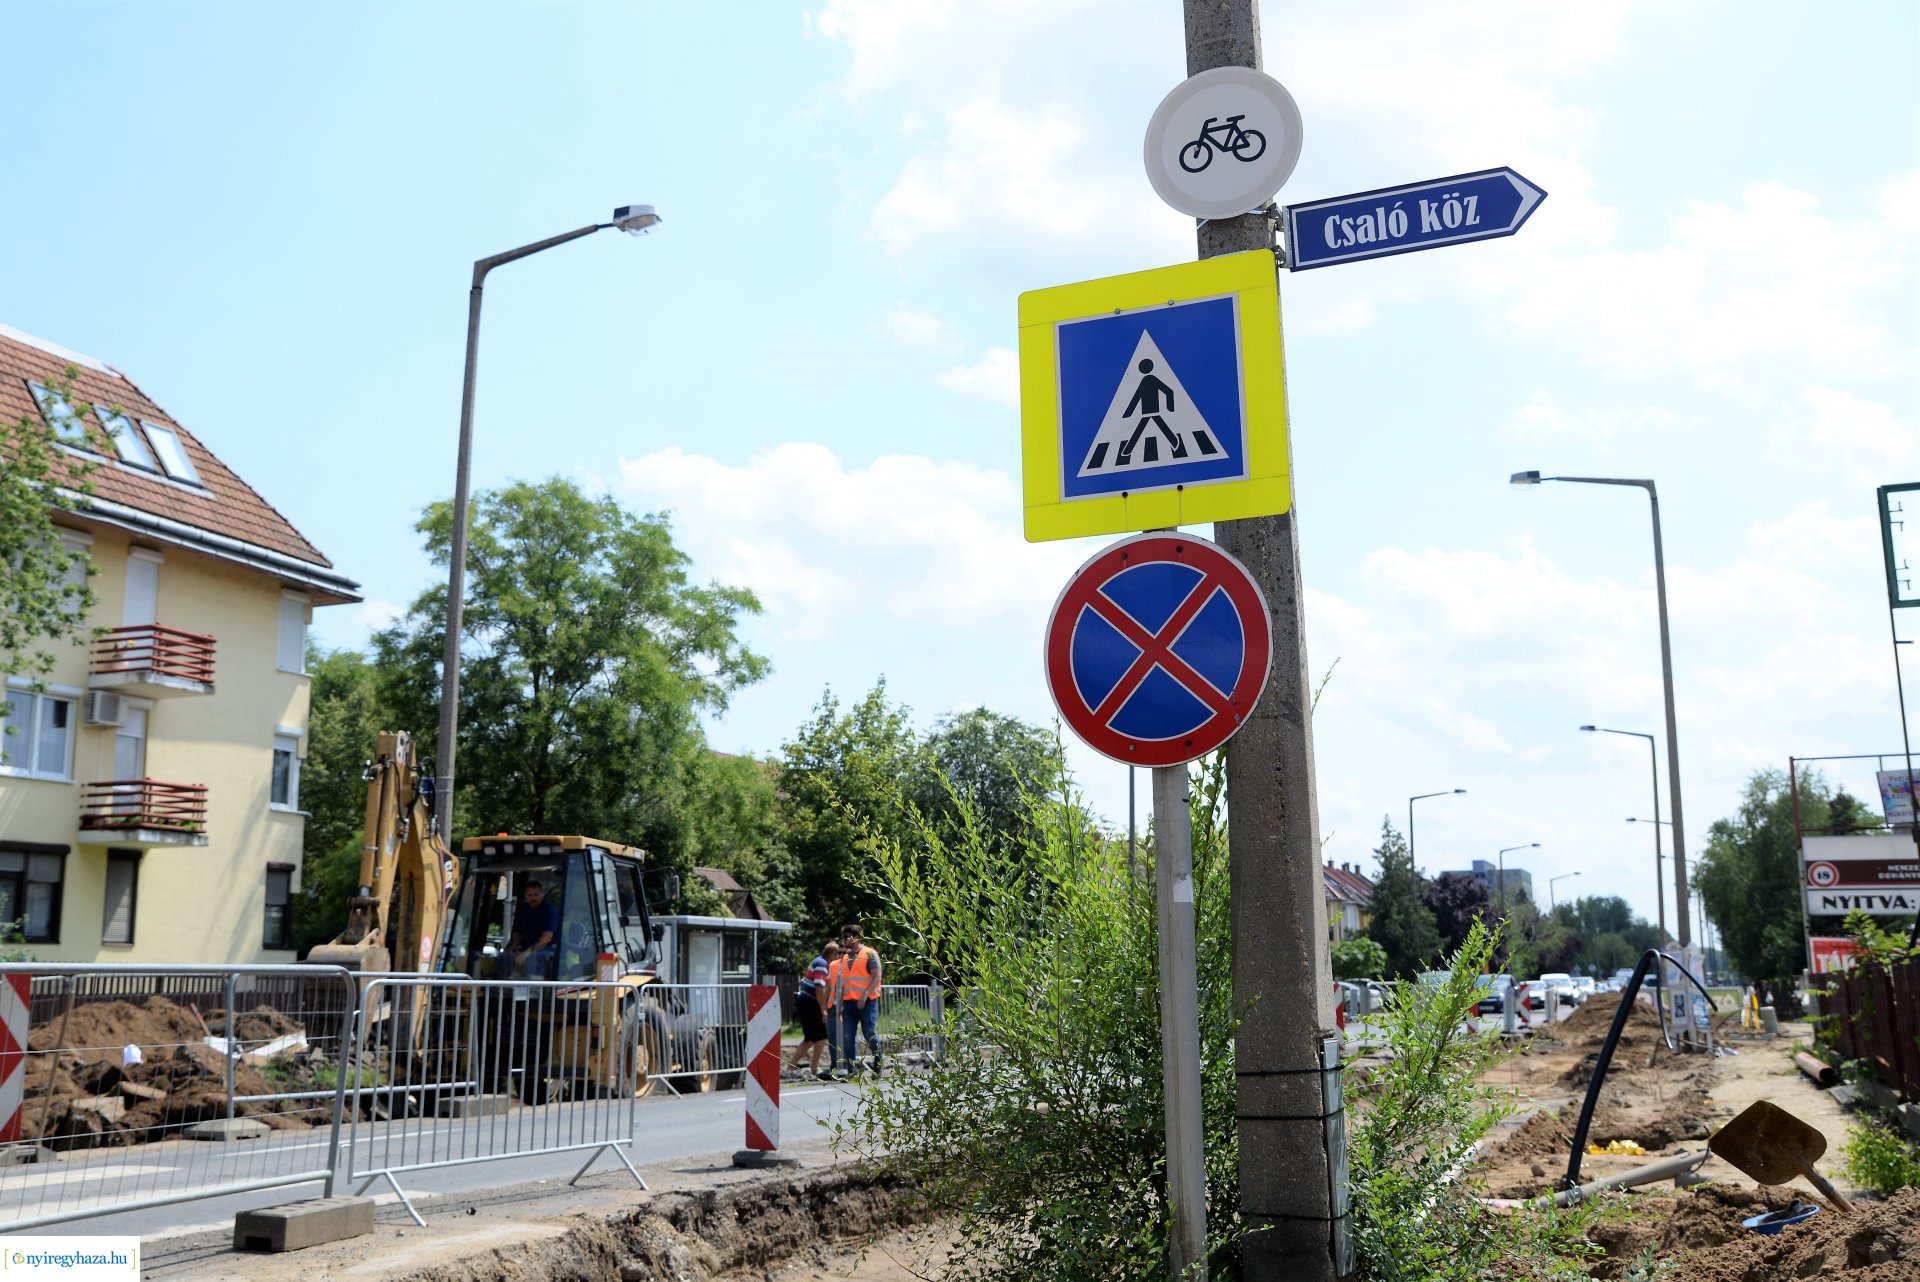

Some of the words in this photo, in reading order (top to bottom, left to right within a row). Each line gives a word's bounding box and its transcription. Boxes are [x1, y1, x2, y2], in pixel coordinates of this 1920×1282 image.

[1324, 201, 1408, 249] Csaló
[1418, 192, 1480, 234] köz
[1822, 895, 1916, 909] NYITVA:
